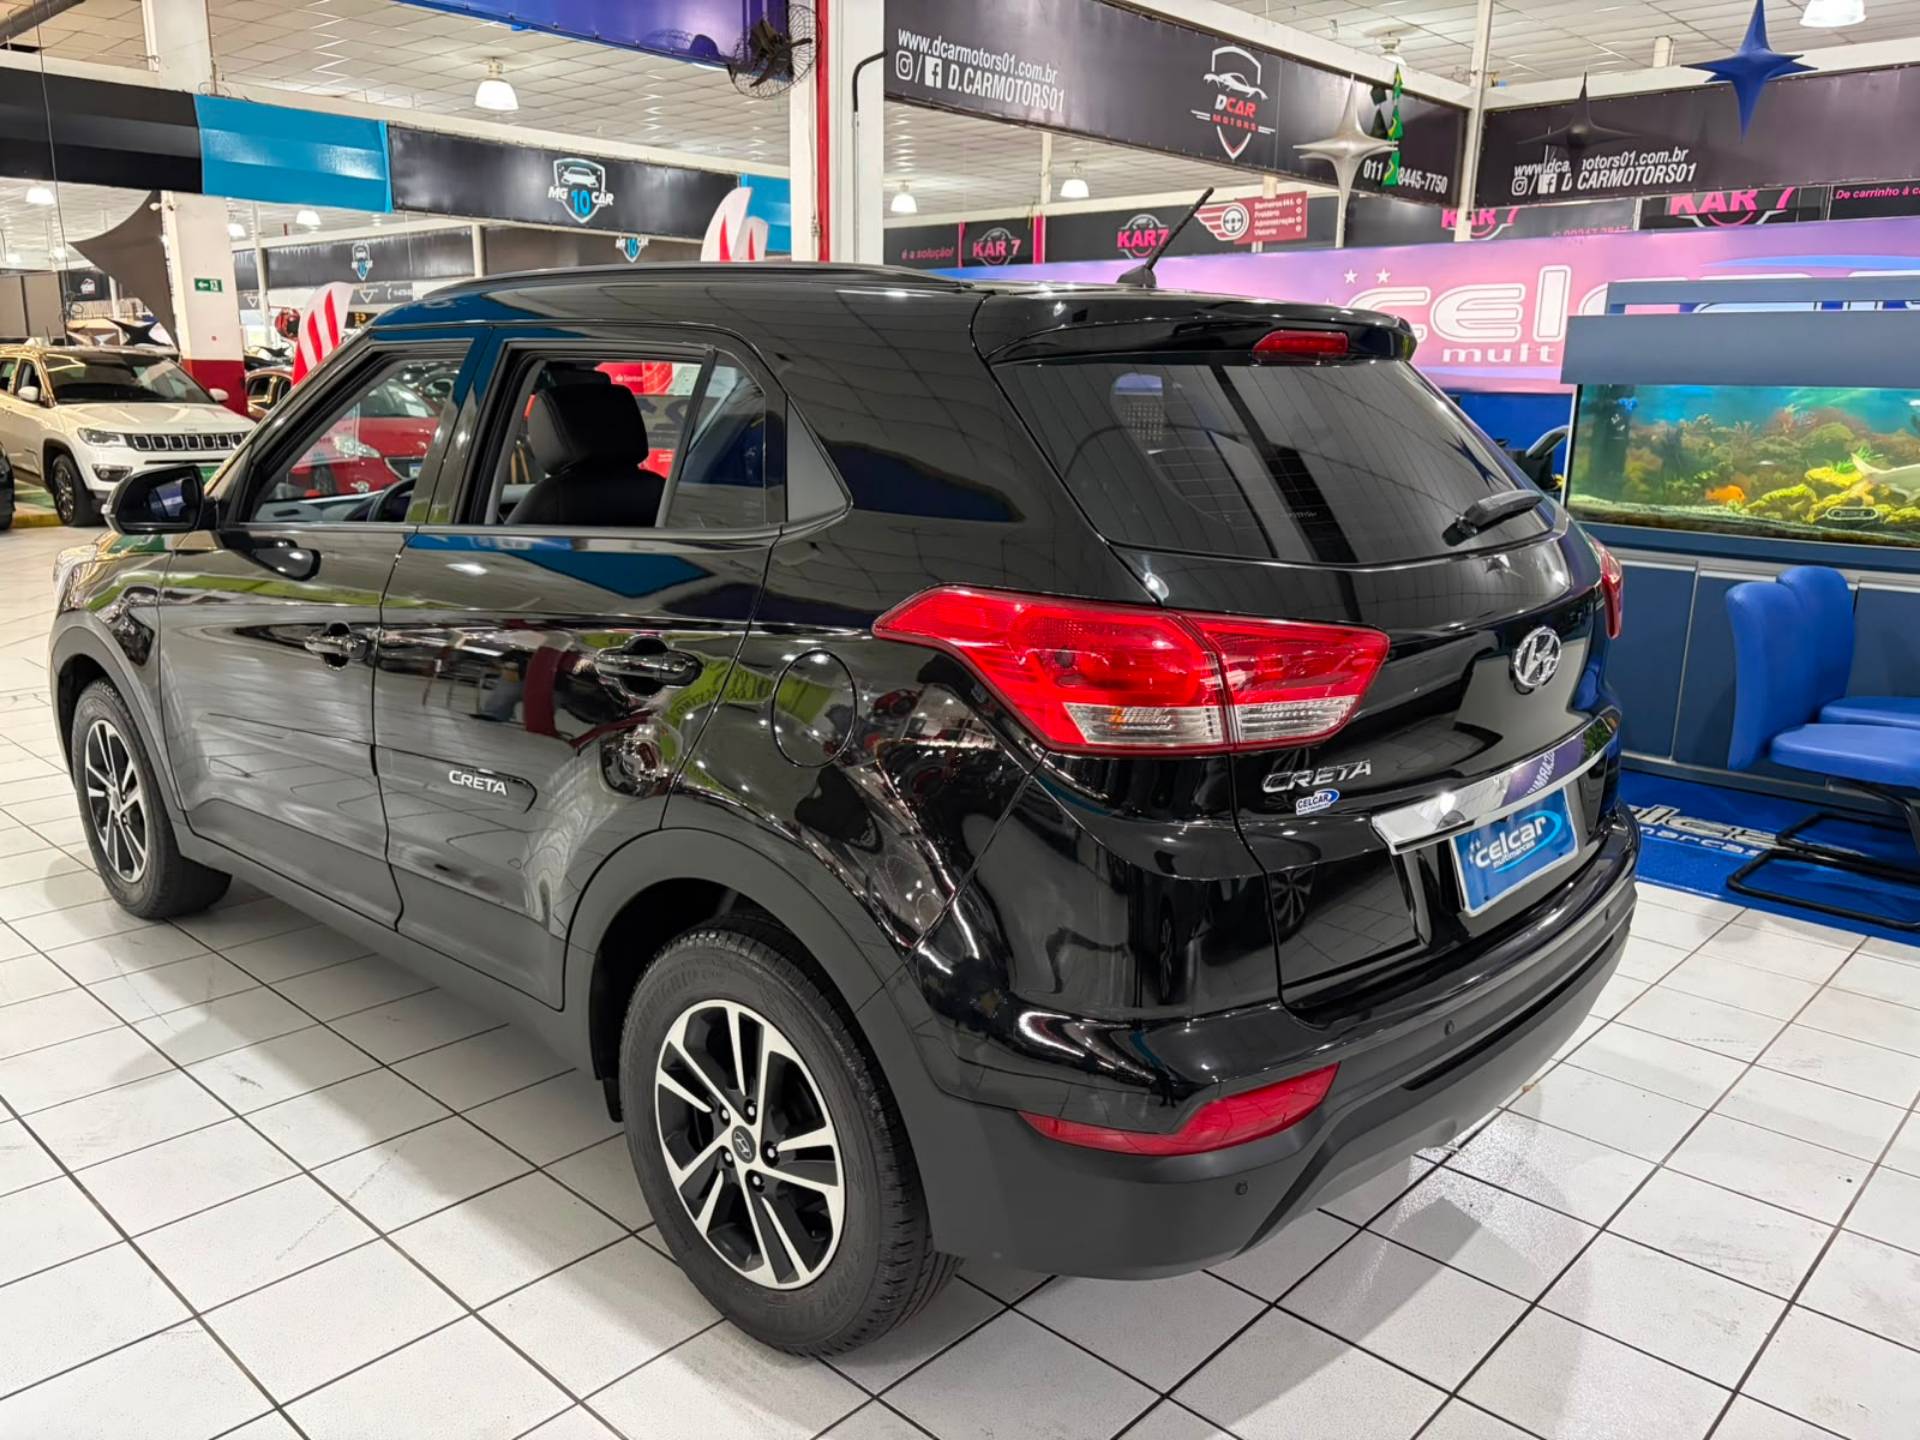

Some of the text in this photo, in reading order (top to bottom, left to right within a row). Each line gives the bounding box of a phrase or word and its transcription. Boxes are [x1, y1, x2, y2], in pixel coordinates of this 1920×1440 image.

[898, 28, 1058, 84] www.dcarmotors01.com.br
[947, 63, 1065, 112] D.CARMOTORS01
[1215, 94, 1256, 118] DCAR
[1363, 159, 1384, 181] 011
[1561, 163, 1697, 192] DCARMOTORS01
[548, 186, 615, 217] MG 10 CAR
[1853, 186, 1900, 199] carrinho
[972, 239, 1022, 258] KAR 7
[448, 769, 508, 797] CRETA
[1262, 759, 1372, 793] CRETA
[1475, 816, 1548, 869] celcar
